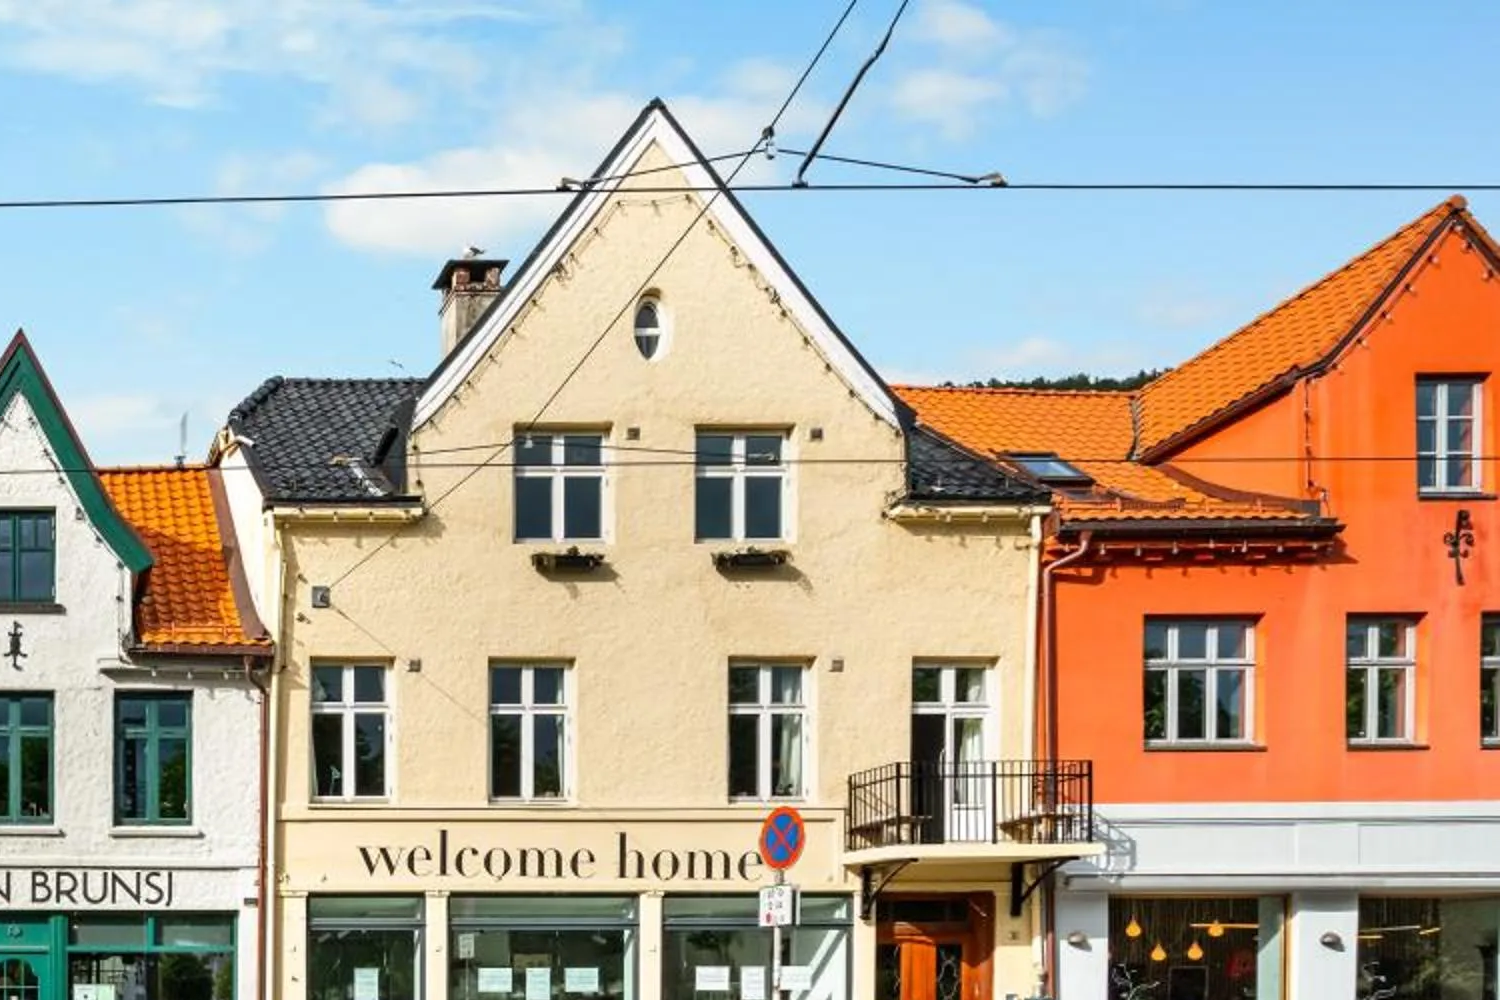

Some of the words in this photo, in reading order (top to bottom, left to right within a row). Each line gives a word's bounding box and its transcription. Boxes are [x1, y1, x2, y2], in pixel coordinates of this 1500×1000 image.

[356, 829, 596, 882] welcome
[615, 831, 764, 882] home
[31, 871, 173, 906] BRUNSJ
